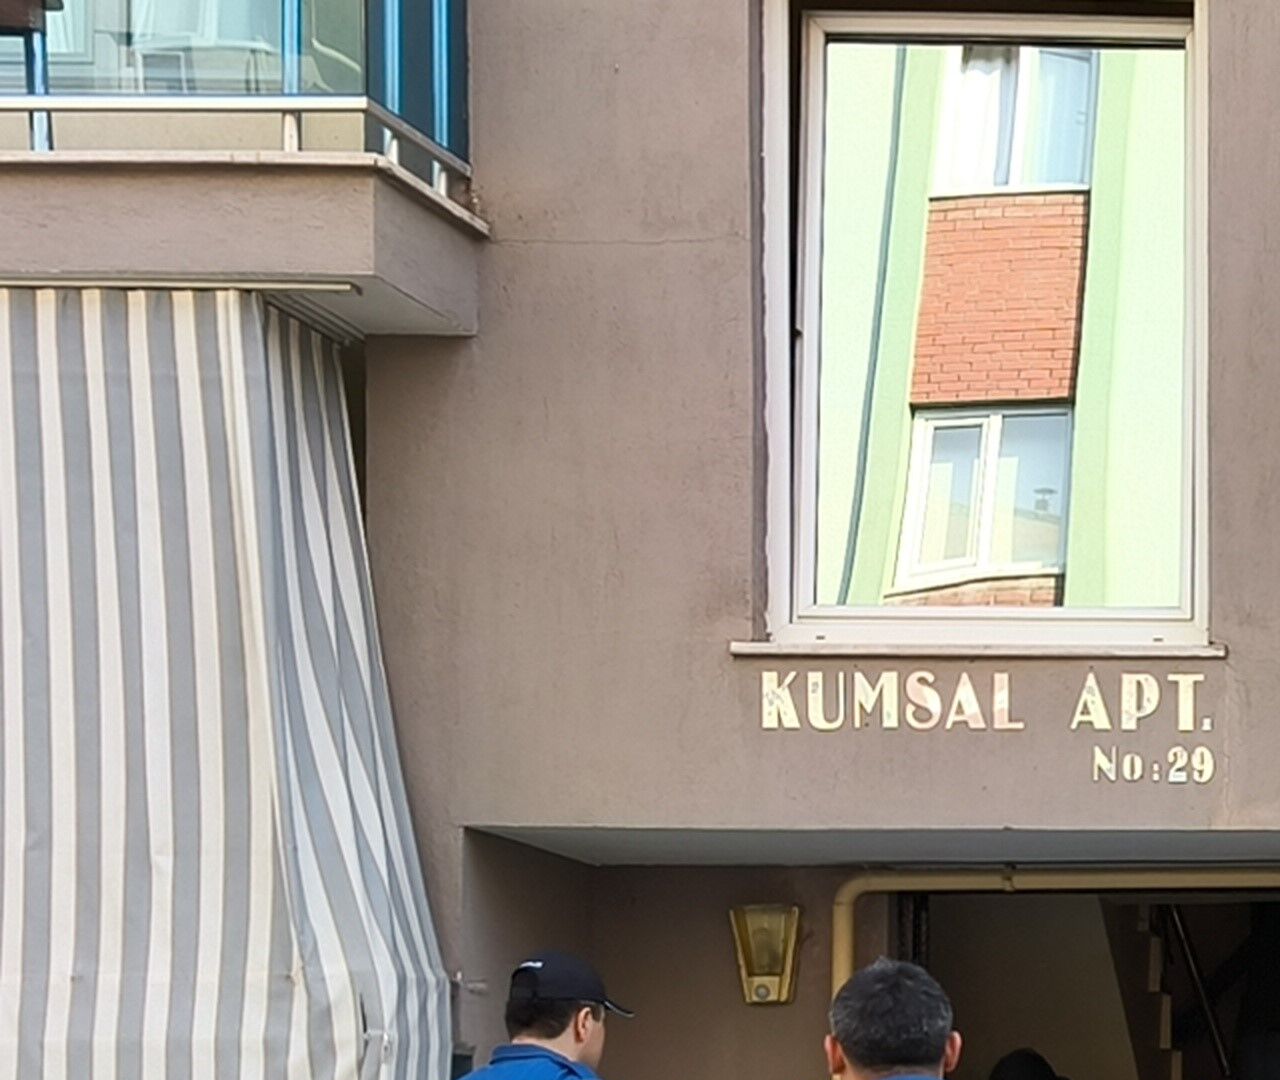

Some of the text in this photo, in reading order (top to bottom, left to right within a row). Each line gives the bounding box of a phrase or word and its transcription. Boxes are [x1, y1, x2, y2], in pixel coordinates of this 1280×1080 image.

[761, 670, 1213, 731] KUMSAL APT.
[1092, 745, 1216, 784] No:29
